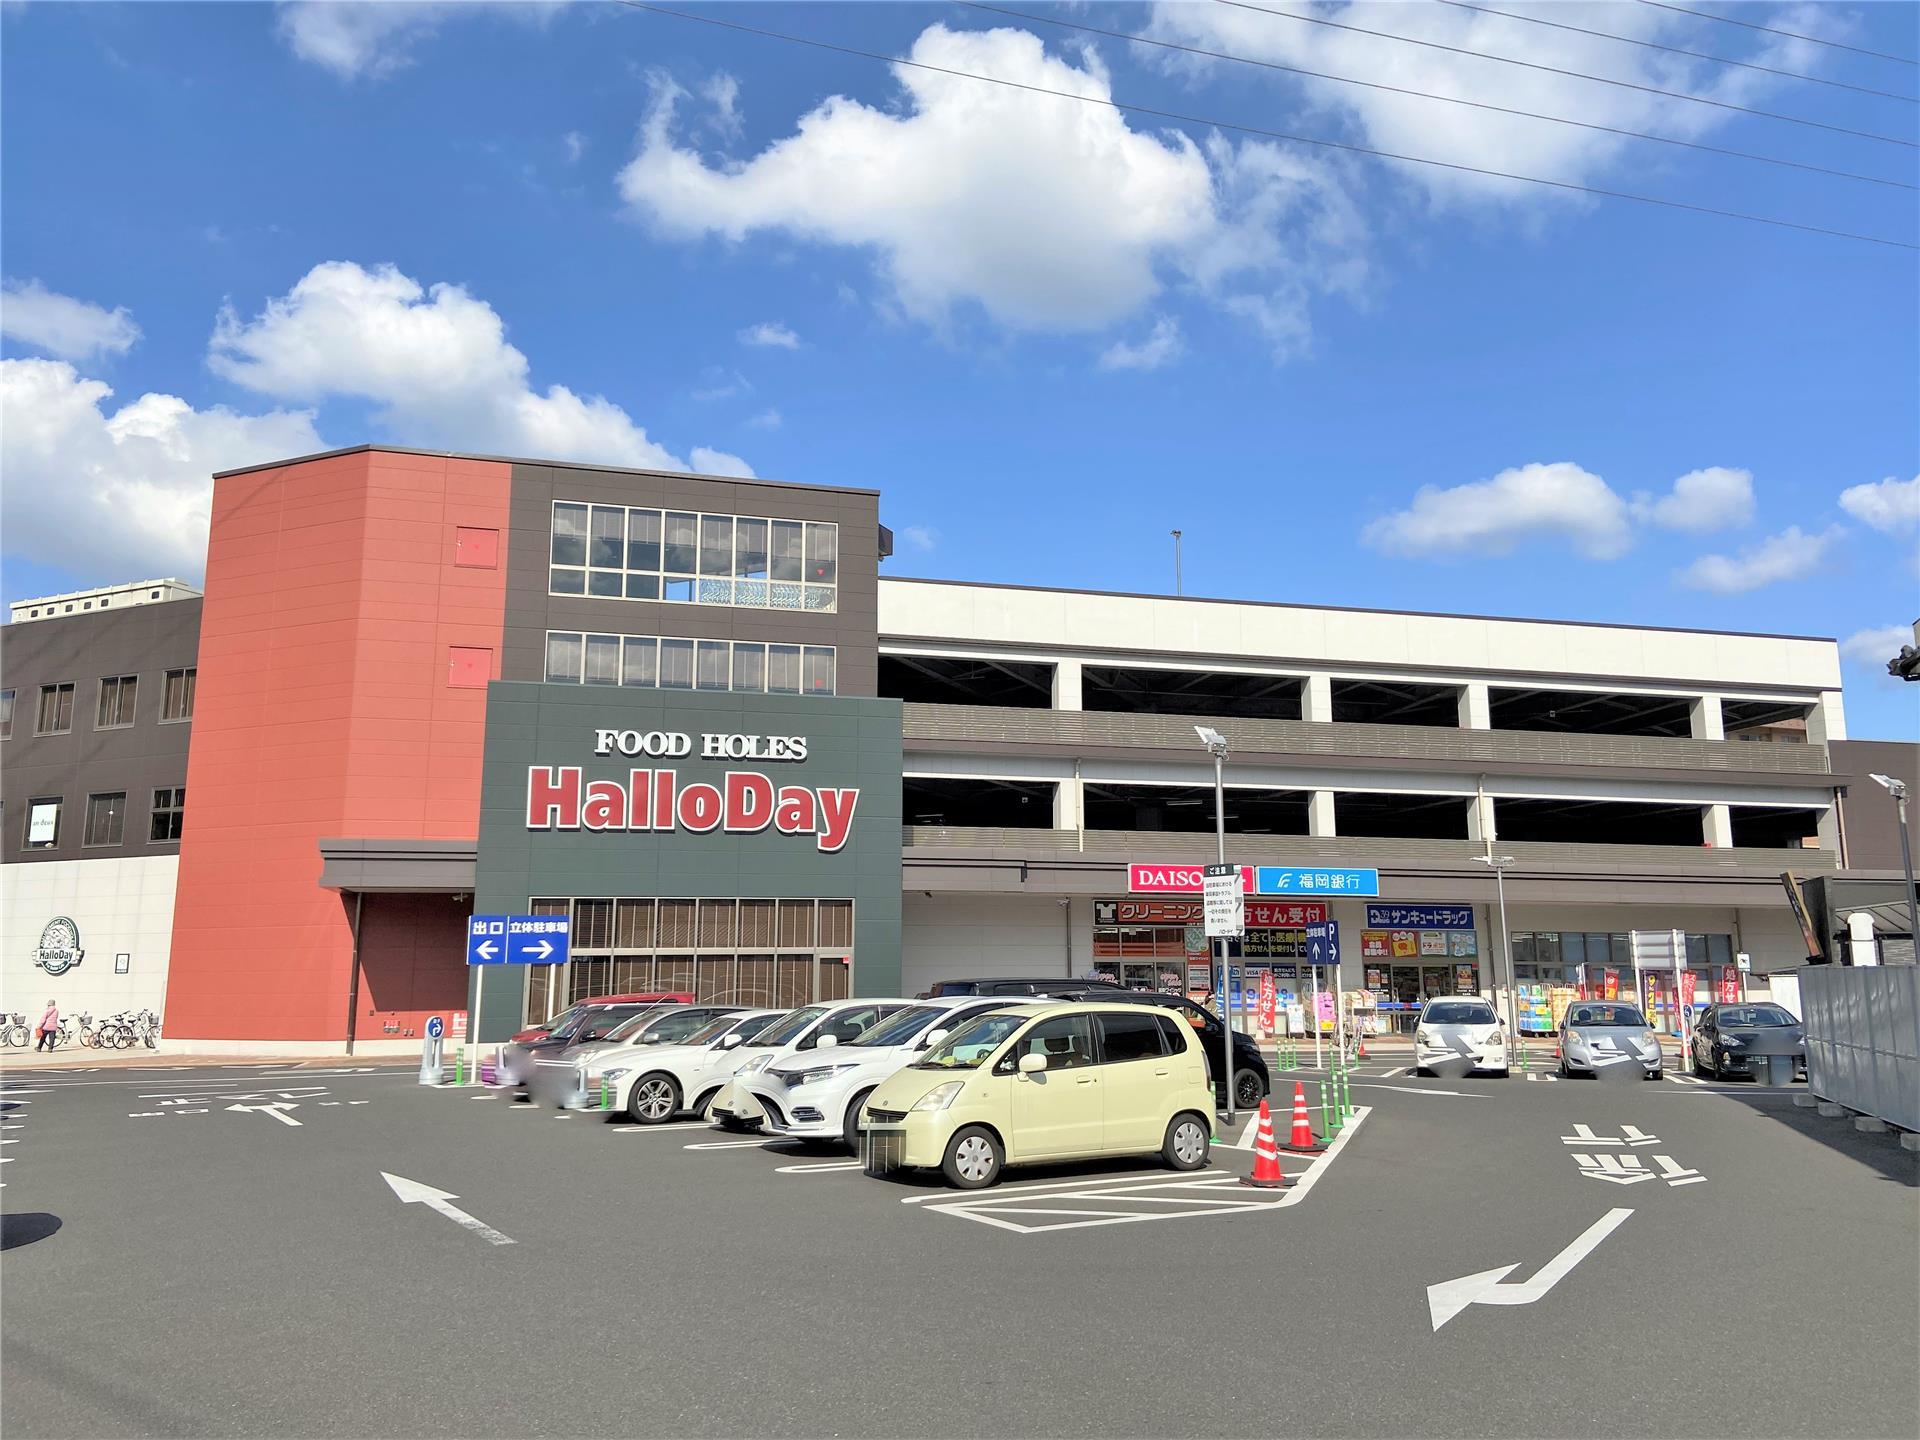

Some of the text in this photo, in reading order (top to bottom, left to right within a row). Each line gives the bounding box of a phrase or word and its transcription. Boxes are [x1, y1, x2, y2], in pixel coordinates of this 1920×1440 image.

[594, 730, 807, 760] FOOD HOLES
[526, 766, 860, 852] HalloDay
[1138, 870, 1203, 886] DAISO
[1299, 873, 1360, 889] 福岡銀行
[1391, 910, 1470, 925] サンキュードラッグ
[473, 921, 504, 934] 出口
[509, 921, 568, 934] 立体駐車場
[1329, 923, 1335, 941] P
[39, 950, 73, 960] HalloDay
